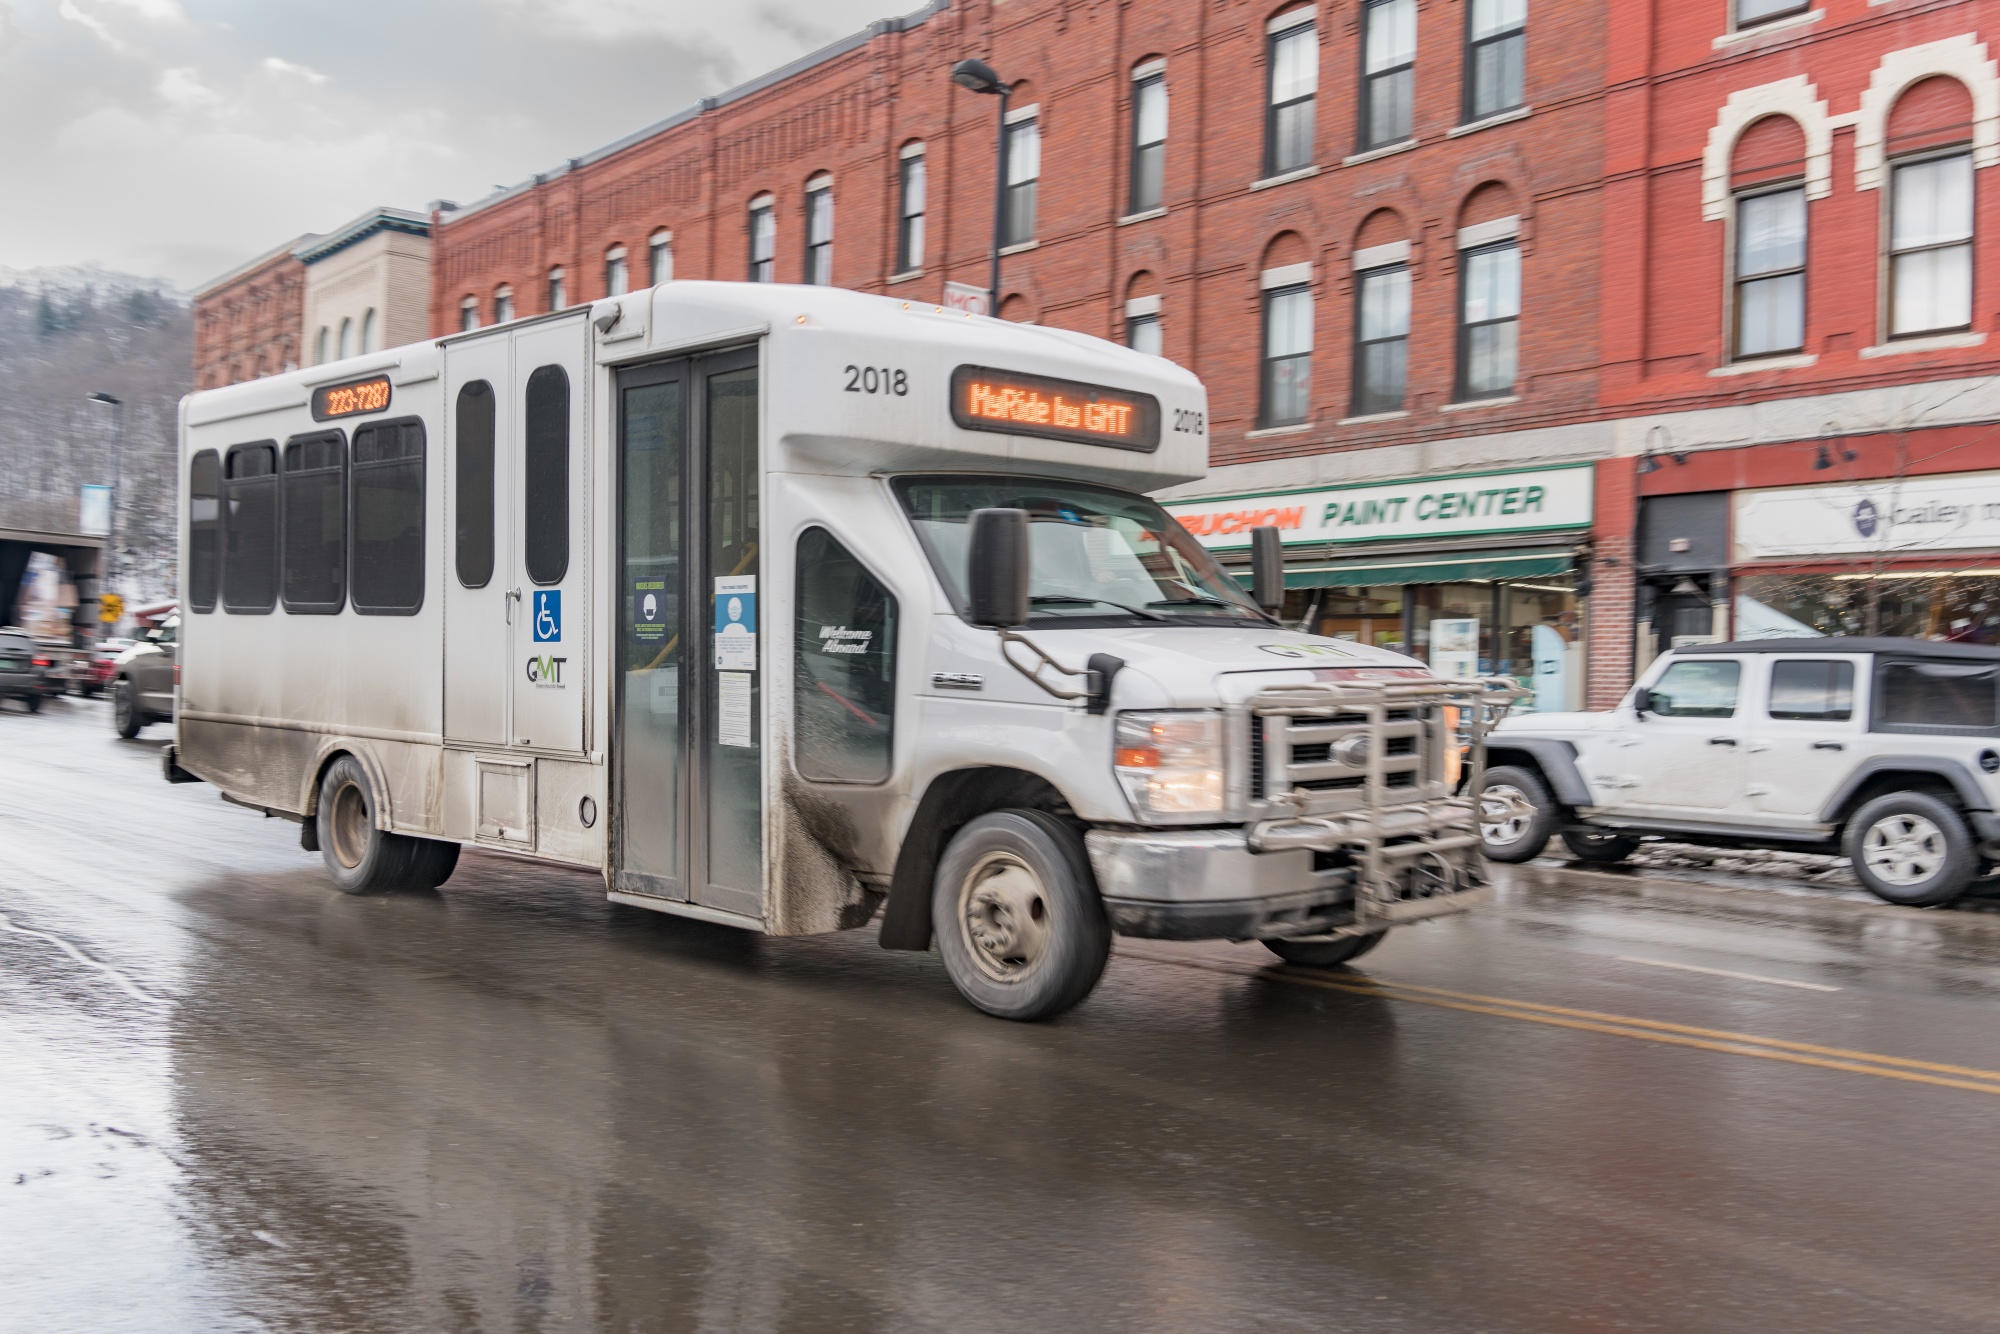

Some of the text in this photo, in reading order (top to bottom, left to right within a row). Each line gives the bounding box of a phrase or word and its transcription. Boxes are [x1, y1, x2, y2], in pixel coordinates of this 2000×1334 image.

[844, 365, 909, 397] 2018
[328, 381, 389, 415] 223-7287
[969, 383, 1132, 434] MyRide by GMT
[1173, 407, 1205, 436] 2018
[1320, 497, 1409, 528] PAINT
[1415, 485, 1546, 521] CENTER
[526, 654, 568, 683] GMT
